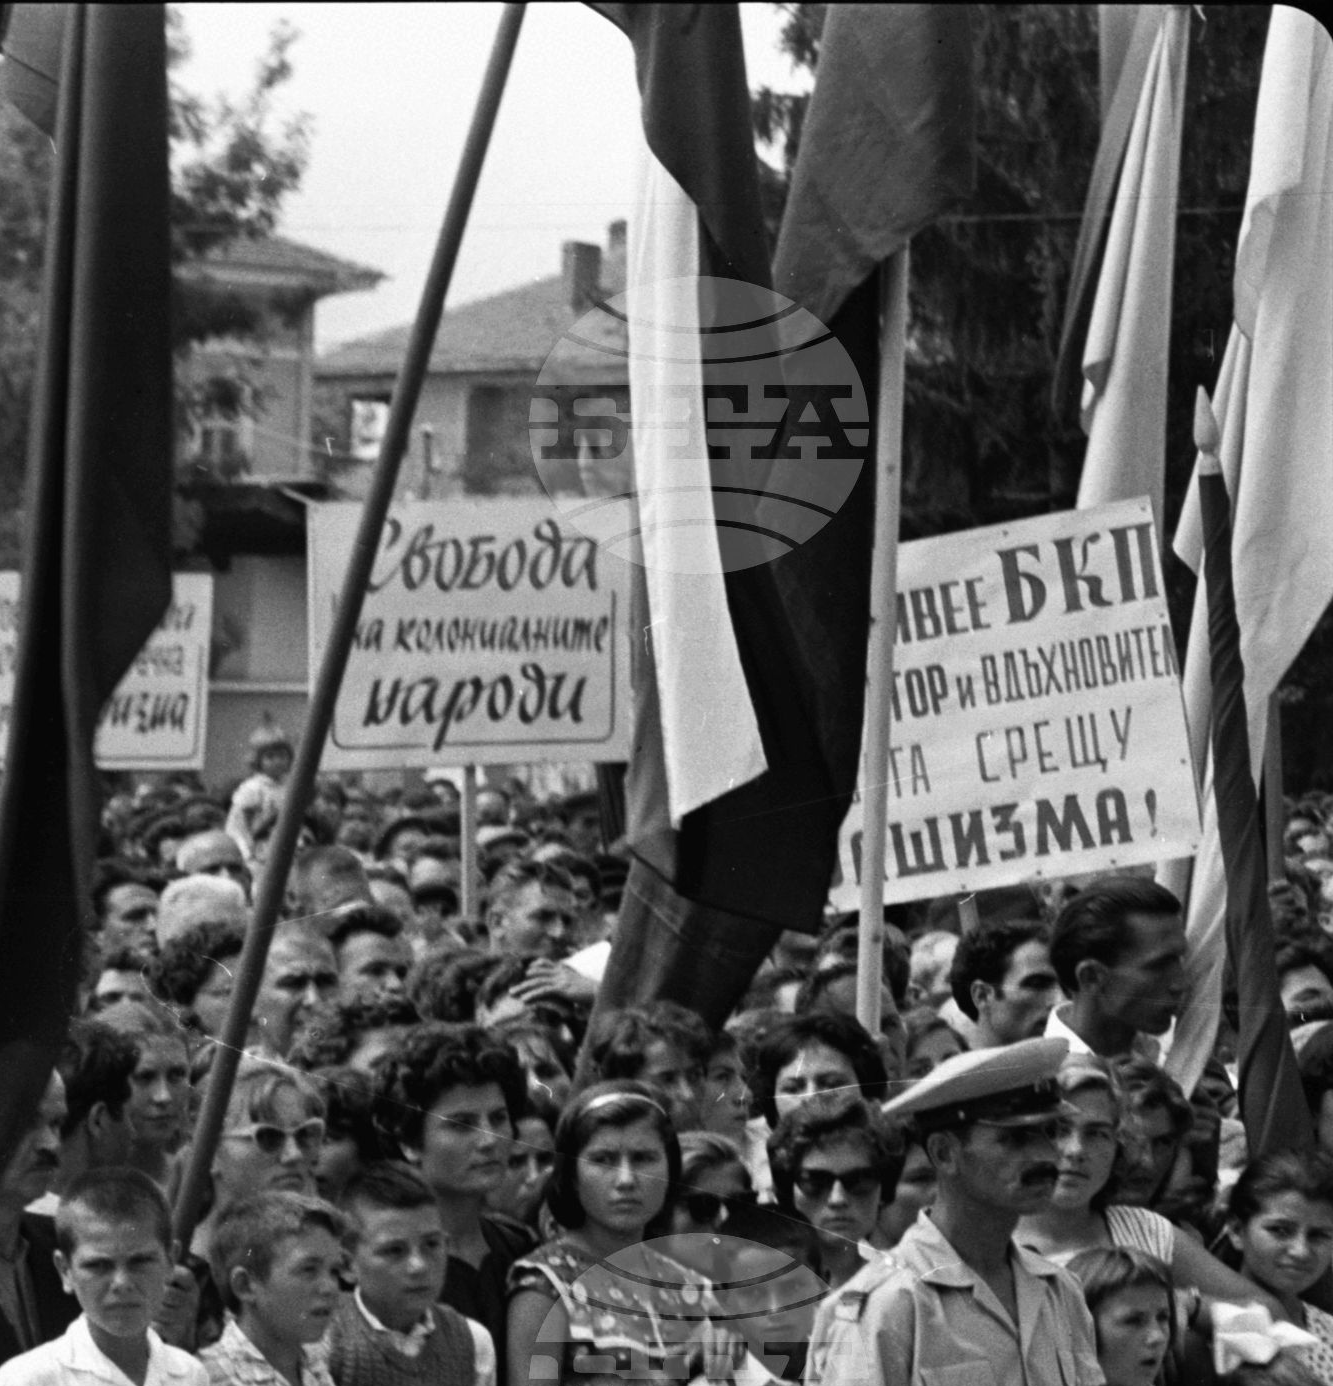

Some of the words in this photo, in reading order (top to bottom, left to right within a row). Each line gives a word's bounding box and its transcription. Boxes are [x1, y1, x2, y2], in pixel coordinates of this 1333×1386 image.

[366, 517, 599, 595] Свобода
[996, 522, 1161, 625] БКП
[394, 614, 610, 654] колониалните
[980, 622, 1180, 707] ВДЪХНОВИТЕЛ
[361, 662, 589, 753] народи
[974, 705, 1134, 784] СРЕЩУ
